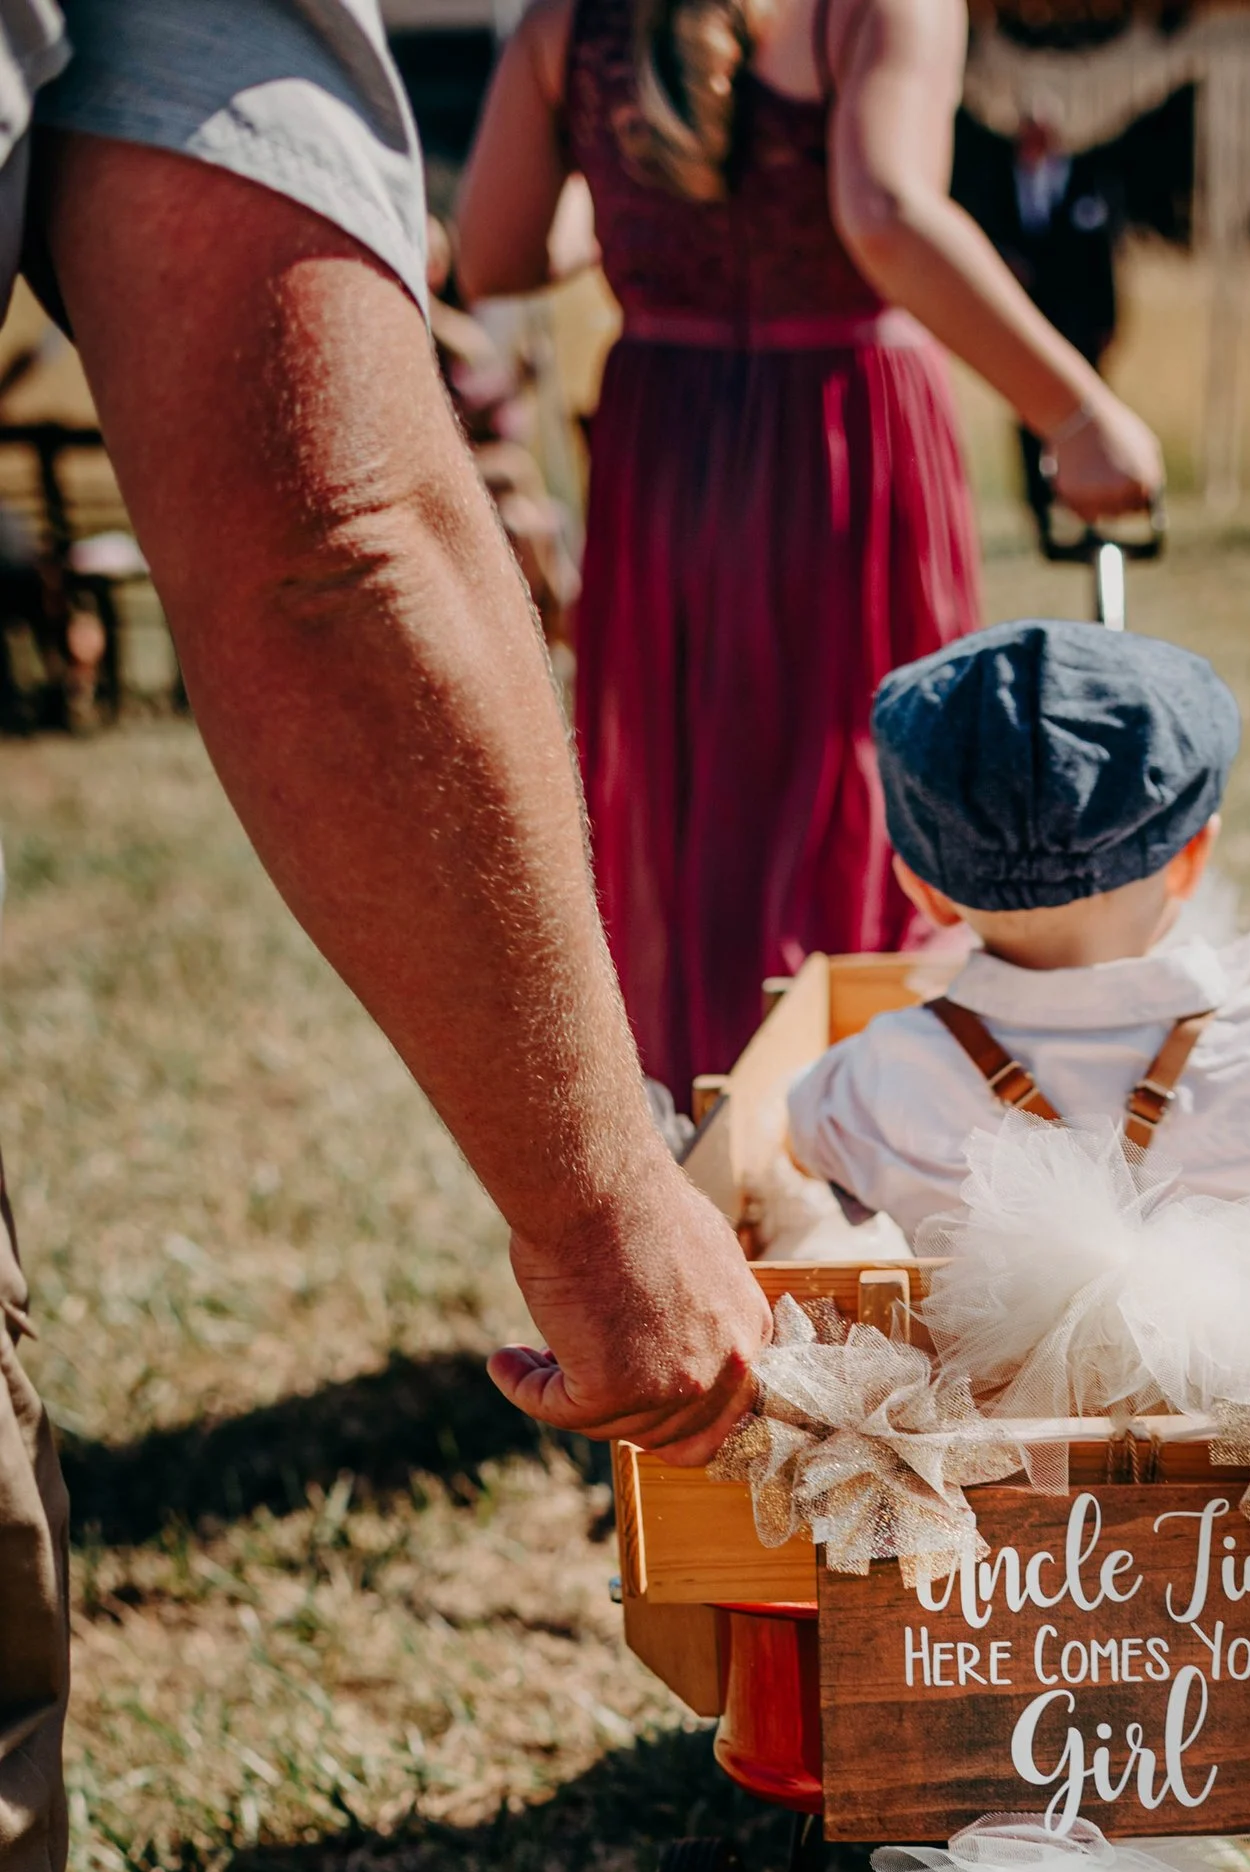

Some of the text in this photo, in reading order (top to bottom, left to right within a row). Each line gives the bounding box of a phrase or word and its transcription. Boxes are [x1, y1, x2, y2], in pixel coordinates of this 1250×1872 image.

[904, 1625, 1013, 1688] HERE
[1034, 1623, 1171, 1685] COMES
[1010, 1664, 1219, 1837] Girl
